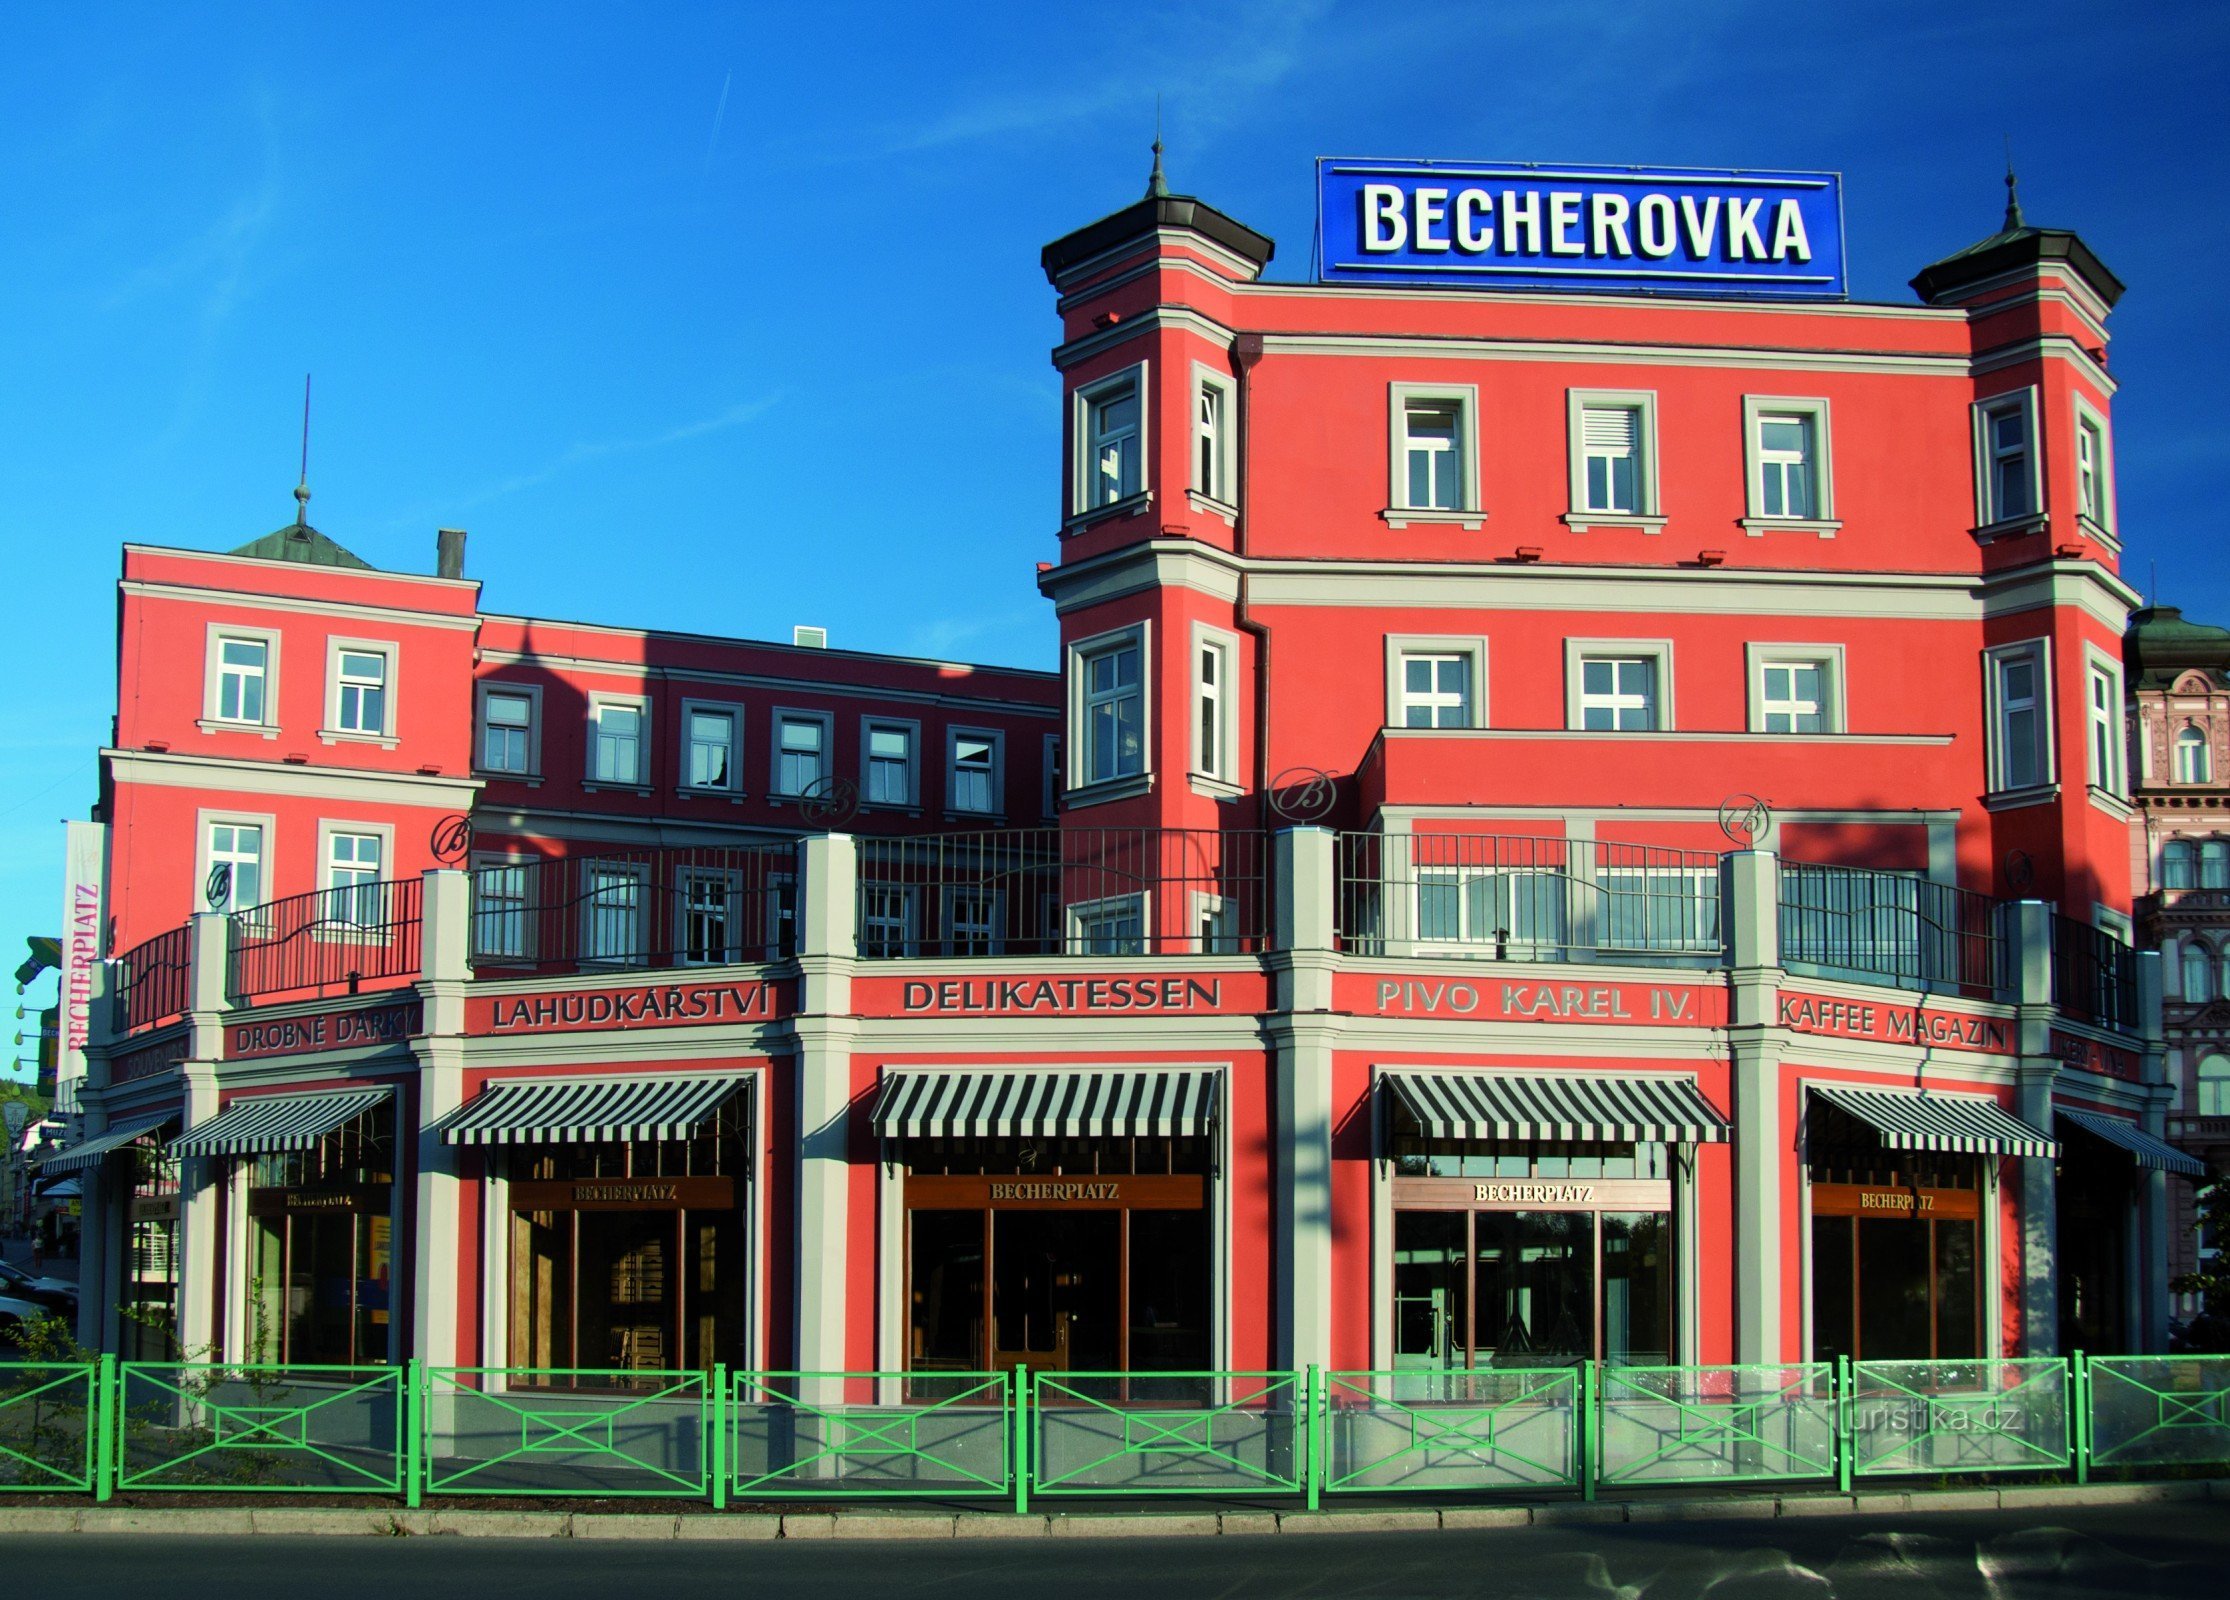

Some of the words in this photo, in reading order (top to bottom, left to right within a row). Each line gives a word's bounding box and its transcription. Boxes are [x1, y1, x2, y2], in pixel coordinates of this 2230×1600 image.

[1363, 184, 1812, 260] BECHEROVKA
[68, 883, 99, 1052] BECHERPLATZ
[493, 983, 769, 1029] LAHŮDKÁŘSTVÍ
[903, 978, 1221, 1011] DELIKATESSEN
[1377, 979, 1479, 1013] PIVO
[1501, 985, 1632, 1018] KAREL
[1651, 989, 1694, 1020] IV.
[236, 1015, 327, 1053] DROBNÉ
[336, 1007, 415, 1043] DÁRKY
[1779, 996, 1876, 1035] KAFFEE
[1886, 1009, 2007, 1050] MAGAZIN
[45, 1128, 68, 1137] MUZ
[573, 1184, 677, 1201] BECHERPLATZ
[991, 1183, 1120, 1200] BECHERPLATZ
[1475, 1184, 1595, 1203] BECHERPLATZ
